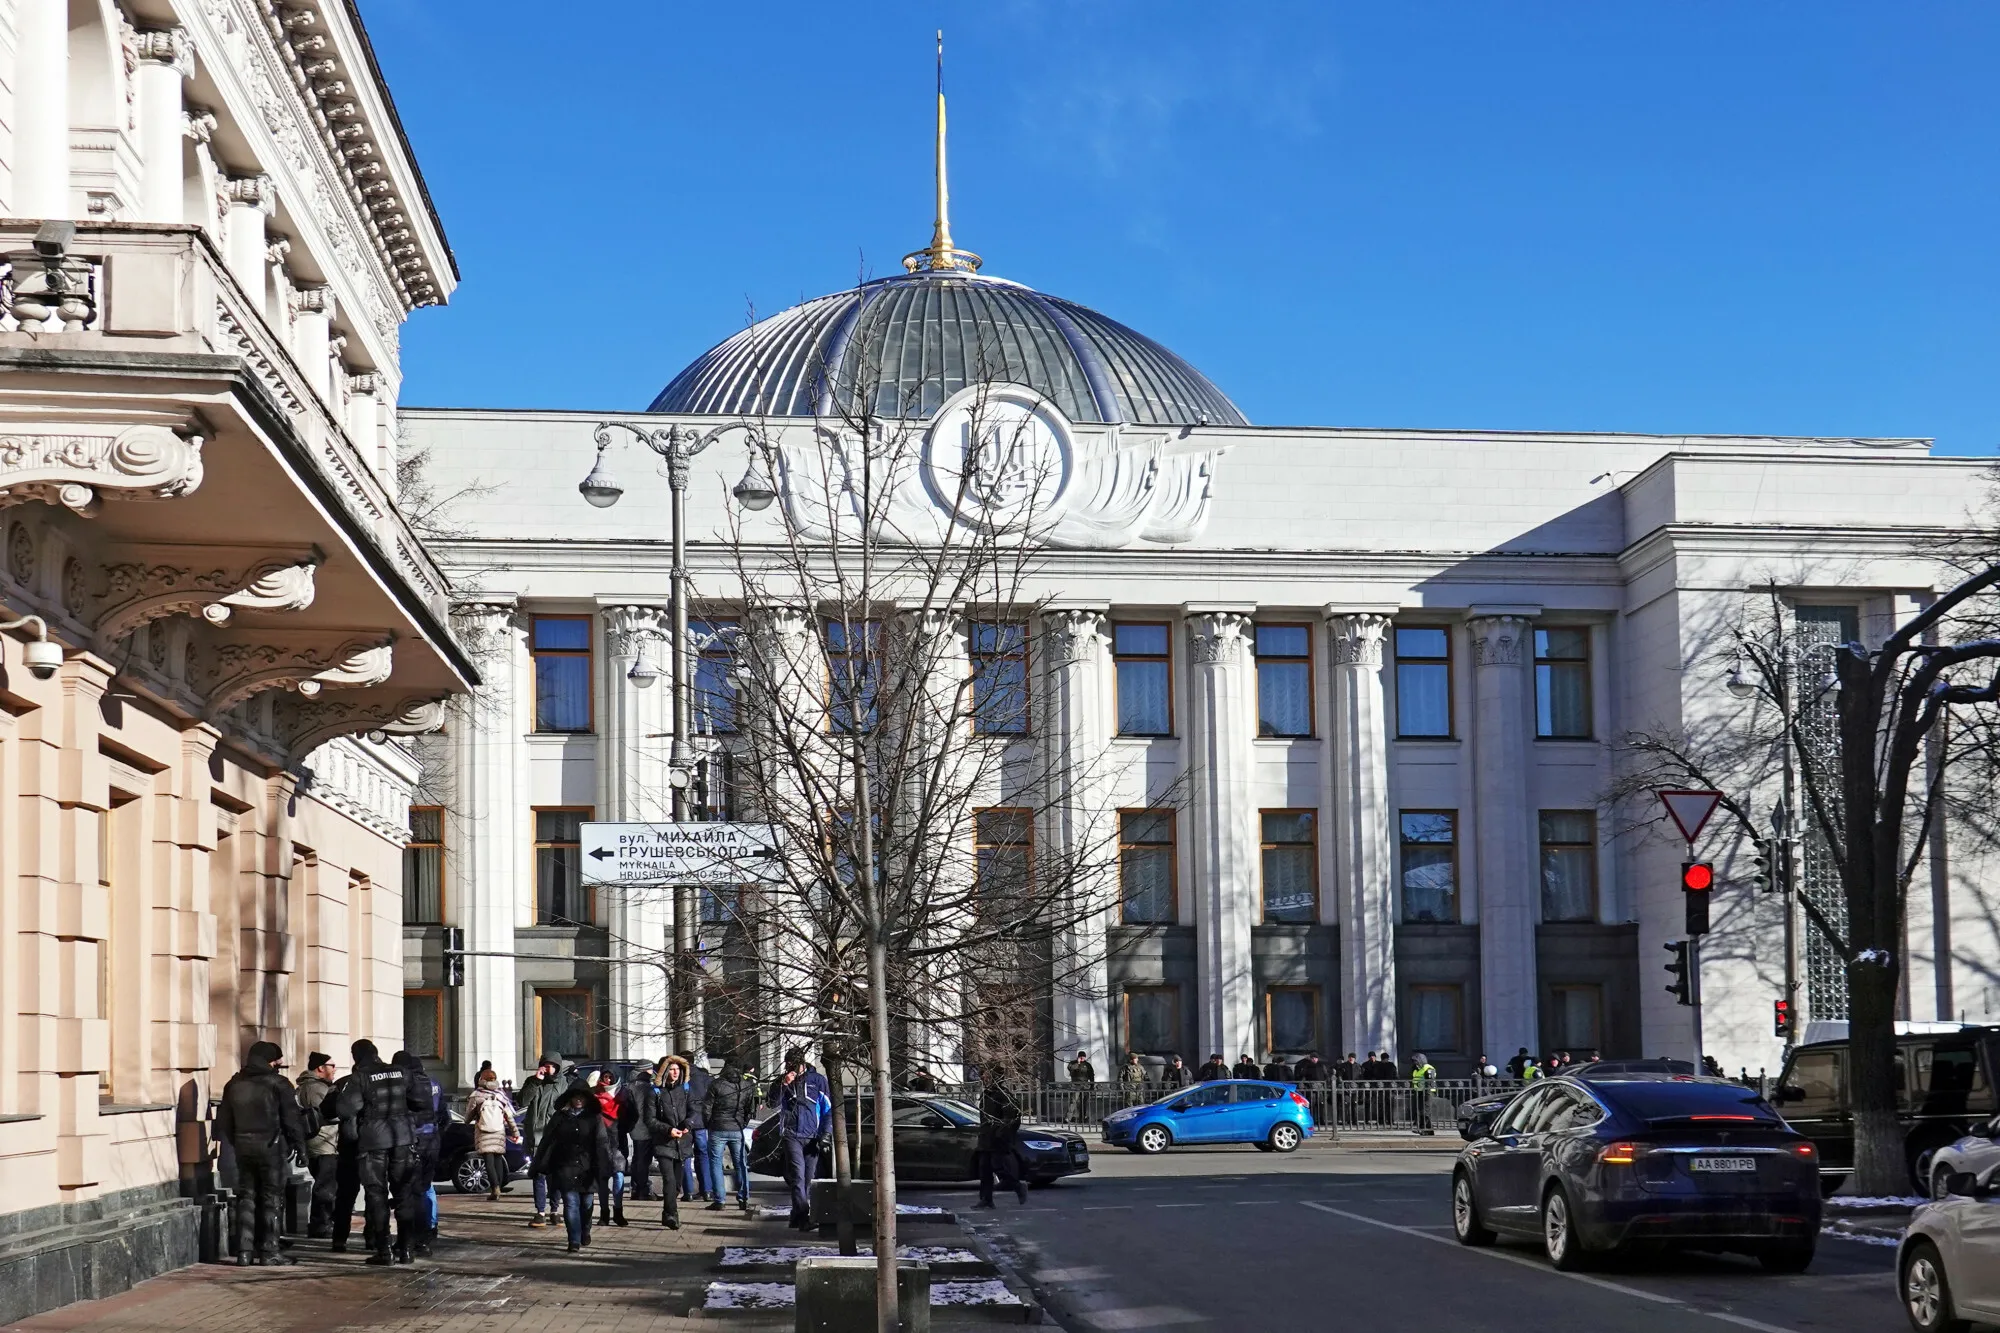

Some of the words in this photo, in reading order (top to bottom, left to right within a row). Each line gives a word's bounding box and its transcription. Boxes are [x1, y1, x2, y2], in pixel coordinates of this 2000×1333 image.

[619, 835, 649, 846] вул.
[657, 828, 737, 843] МИХАЙЛА
[619, 846, 748, 858] ГРУШЕВСЬКОГО
[619, 861, 676, 869] MYKHAILA
